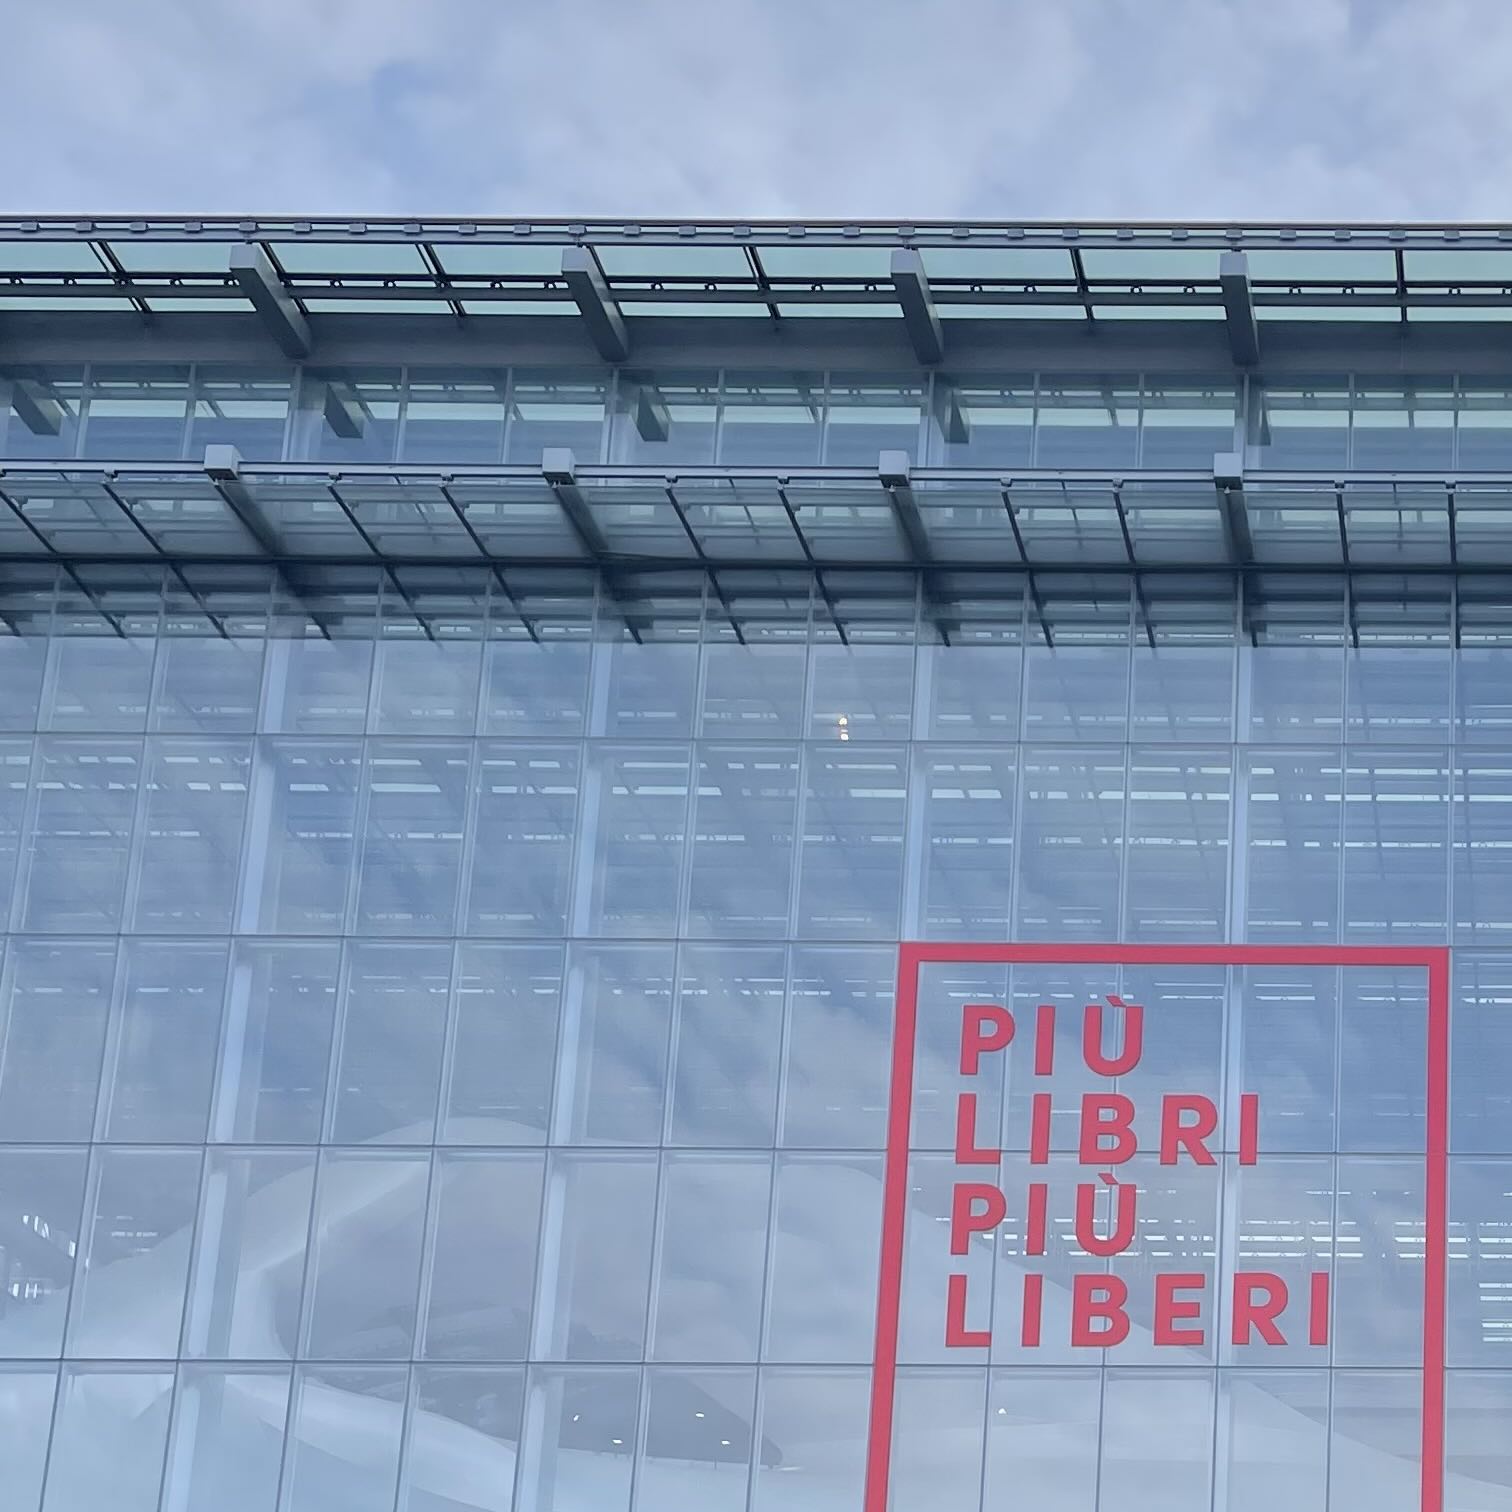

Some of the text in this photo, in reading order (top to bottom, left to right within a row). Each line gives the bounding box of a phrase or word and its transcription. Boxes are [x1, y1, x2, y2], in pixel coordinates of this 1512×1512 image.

[959, 995, 1144, 1077] PIÙ
[955, 1093, 1259, 1166] LIBRI
[950, 1173, 1137, 1257] PIÙ
[945, 1272, 1329, 1348] LIBERI
